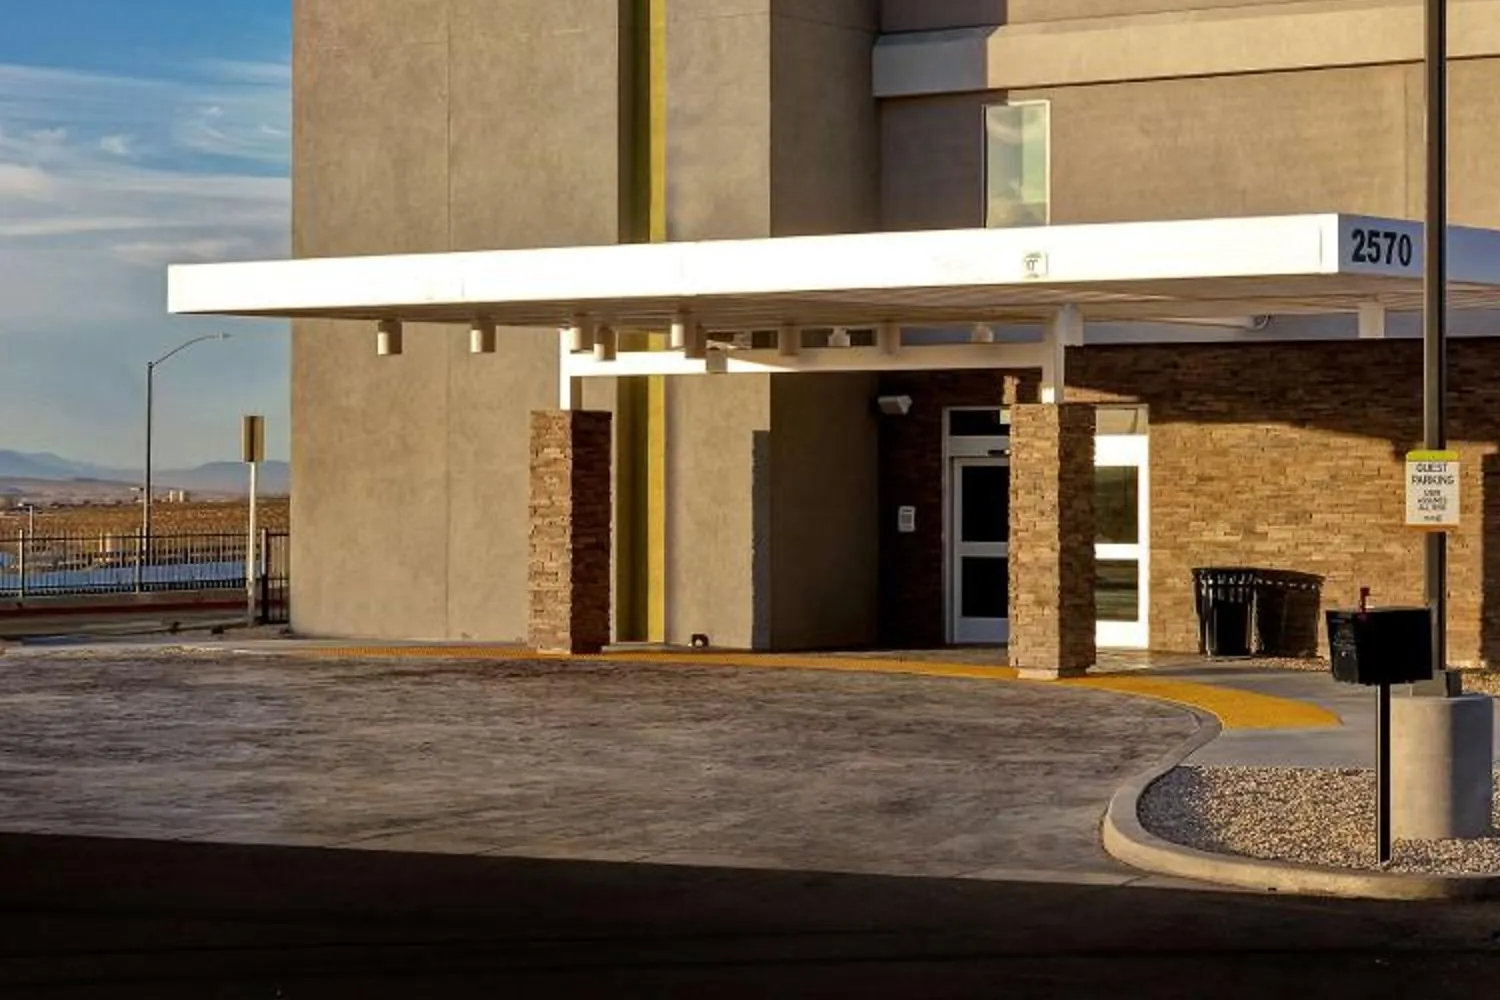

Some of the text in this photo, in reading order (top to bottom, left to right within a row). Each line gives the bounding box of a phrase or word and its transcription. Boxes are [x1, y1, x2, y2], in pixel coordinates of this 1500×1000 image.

[1351, 228, 1413, 267] 2570
[1416, 463, 1448, 473] GUEST
[1411, 475, 1455, 485] PARKING
